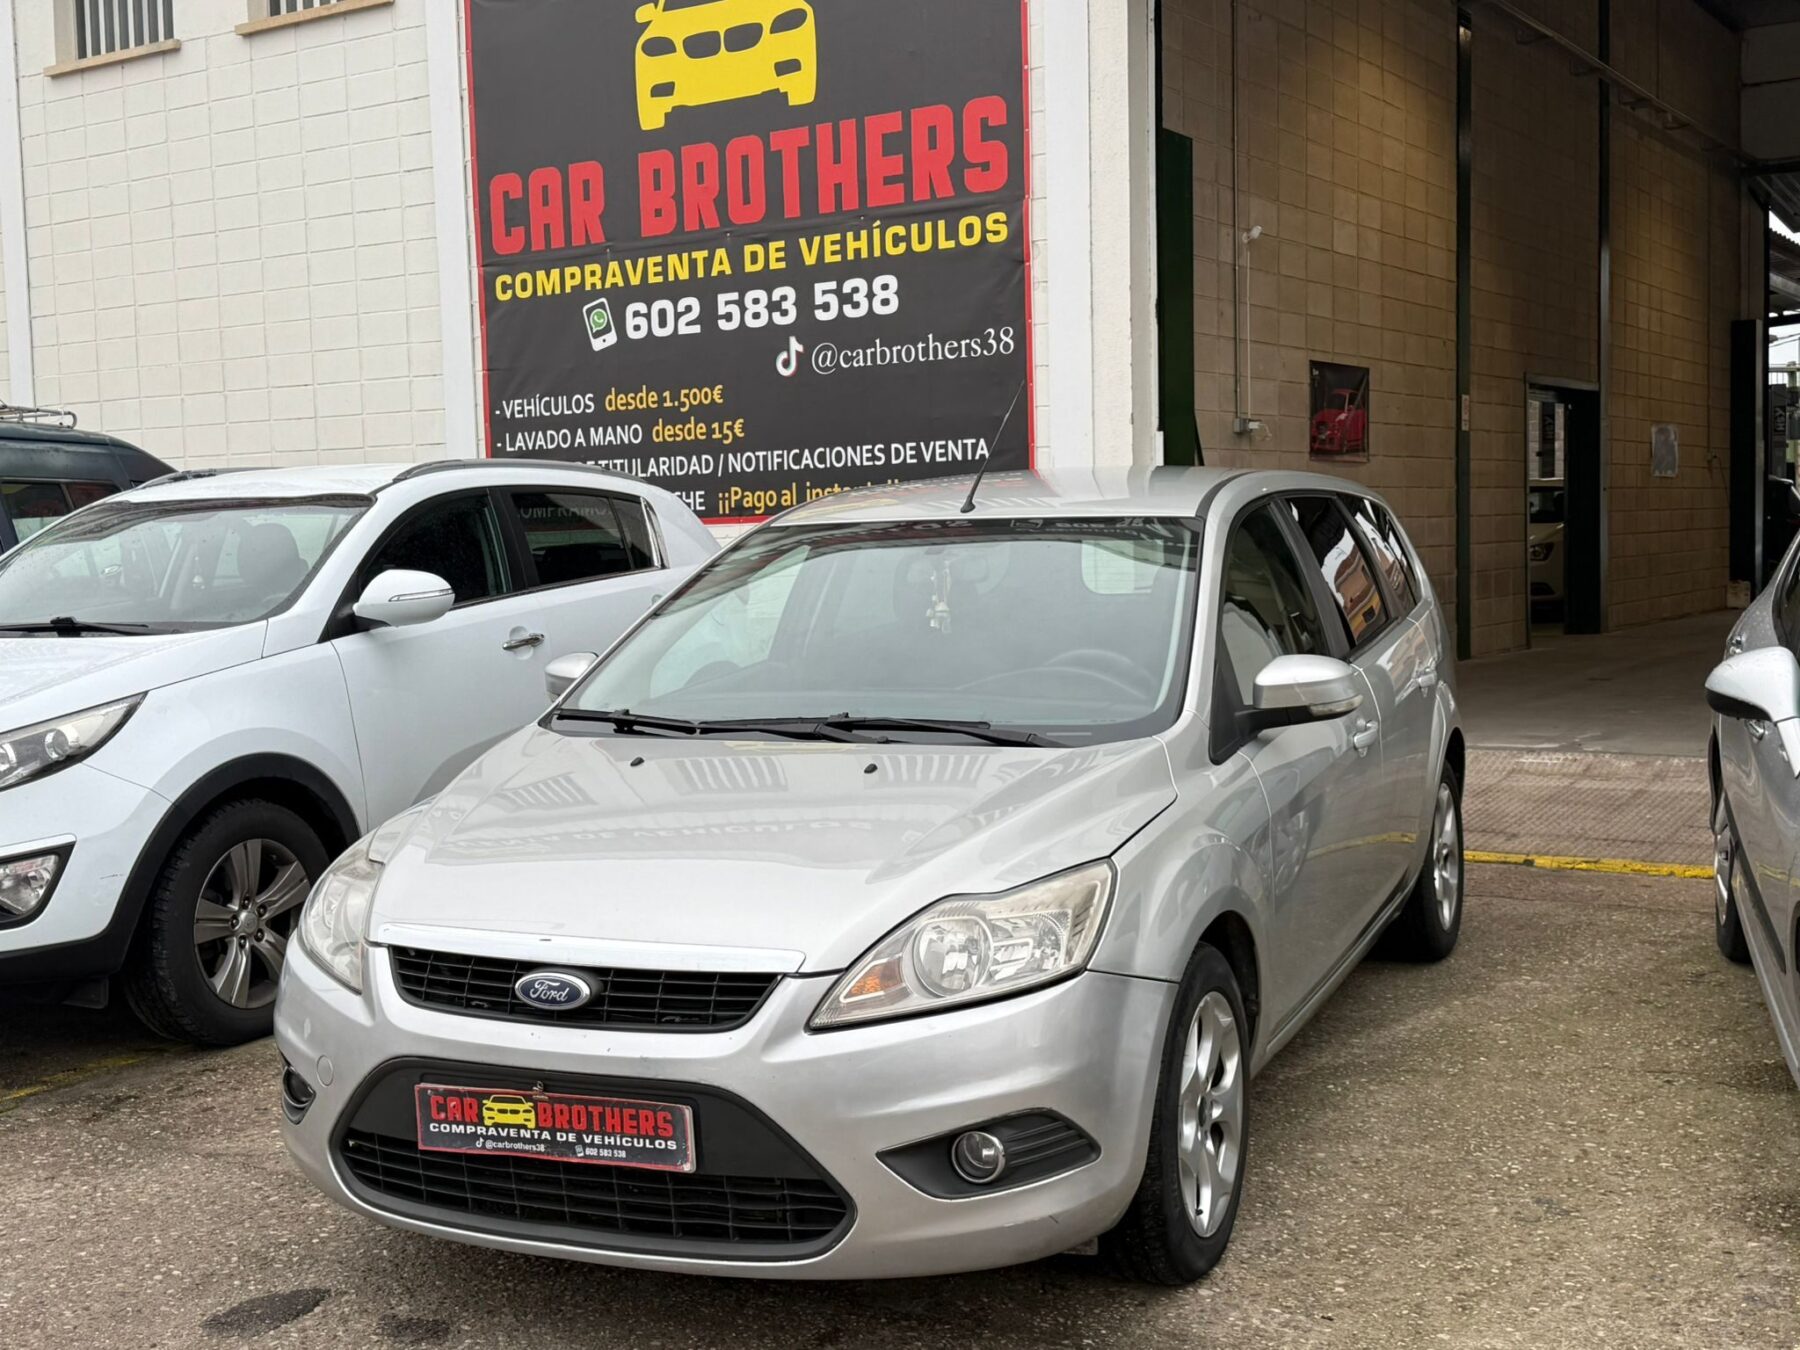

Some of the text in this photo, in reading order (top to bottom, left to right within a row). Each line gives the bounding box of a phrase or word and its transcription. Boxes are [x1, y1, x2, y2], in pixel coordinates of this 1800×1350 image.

[489, 95, 1010, 256] CAR BROTHERS
[495, 211, 1009, 301] COMPRAVENTA DE VEHÍCULOS
[625, 274, 900, 339] 602 583 538
[811, 326, 1014, 375] @carbrothers38
[503, 393, 595, 420] VEHÍCULOS
[605, 385, 658, 412] desde
[663, 385, 724, 412] 1.500€
[506, 428, 571, 452] LAVADO
[574, 428, 586, 448] A
[590, 423, 643, 447] MANO
[652, 416, 707, 443] desde
[711, 418, 745, 445] 15€
[728, 446, 885, 472] NOTIFICACIONES
[892, 442, 918, 464] DE
[918, 438, 989, 462] VENTA
[780, 482, 797, 507] al
[529, 979, 570, 1002] Ford
[430, 1095, 674, 1137] CAR BROTHERS
[430, 1122, 677, 1150] COMPRAVENTA DE VEHÍCULOS
[485, 1139, 546, 1153] @carbrothers38
[585, 1147, 598, 1156] 602
